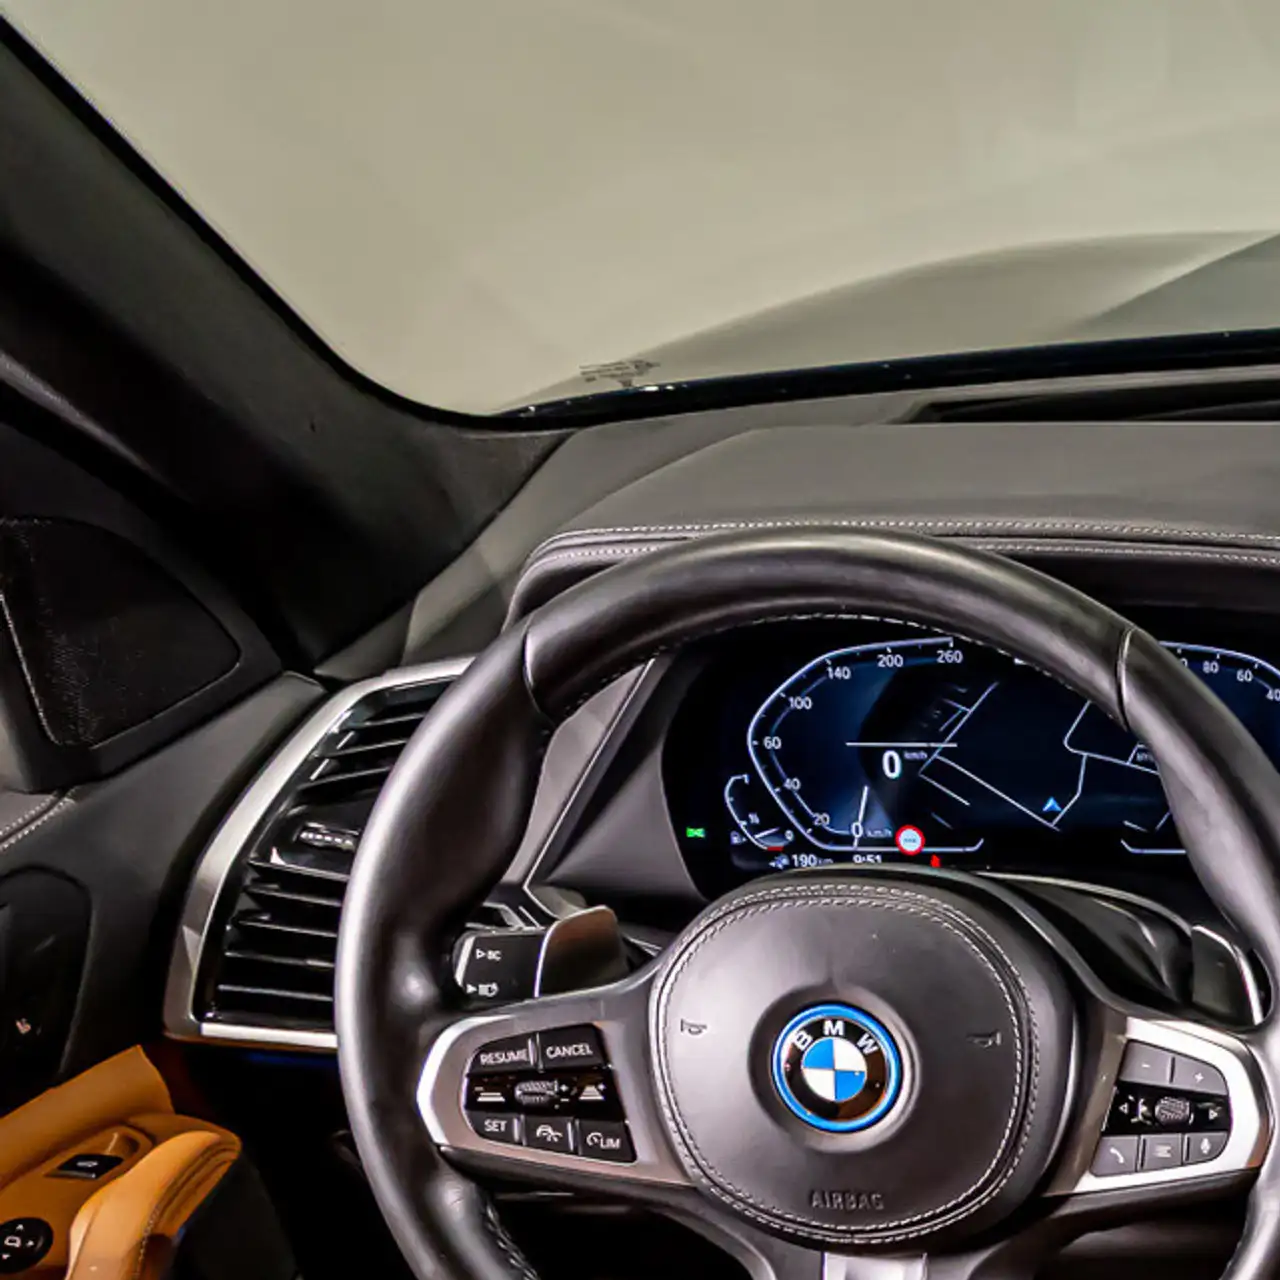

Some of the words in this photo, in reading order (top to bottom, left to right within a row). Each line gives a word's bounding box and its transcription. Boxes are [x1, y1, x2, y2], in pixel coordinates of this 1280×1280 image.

[877, 654, 903, 667] 200
[936, 651, 963, 663] 260
[827, 667, 850, 679] 140
[1203, 661, 1219, 673] 80
[1236, 669, 1253, 682] 60
[788, 697, 812, 709] 100
[764, 738, 782, 749] 60
[882, 750, 902, 779] 0
[784, 777, 801, 790] 40
[813, 813, 830, 826] 20
[852, 822, 863, 838] 0
[792, 854, 817, 868] 190
[792, 1019, 880, 1056] BMW
[480, 1050, 527, 1066] RESUME
[546, 1044, 594, 1059] CANCEL
[484, 1119, 508, 1133] SET
[602, 1135, 622, 1149] LIM
[811, 1190, 885, 1211] AIRBAG
